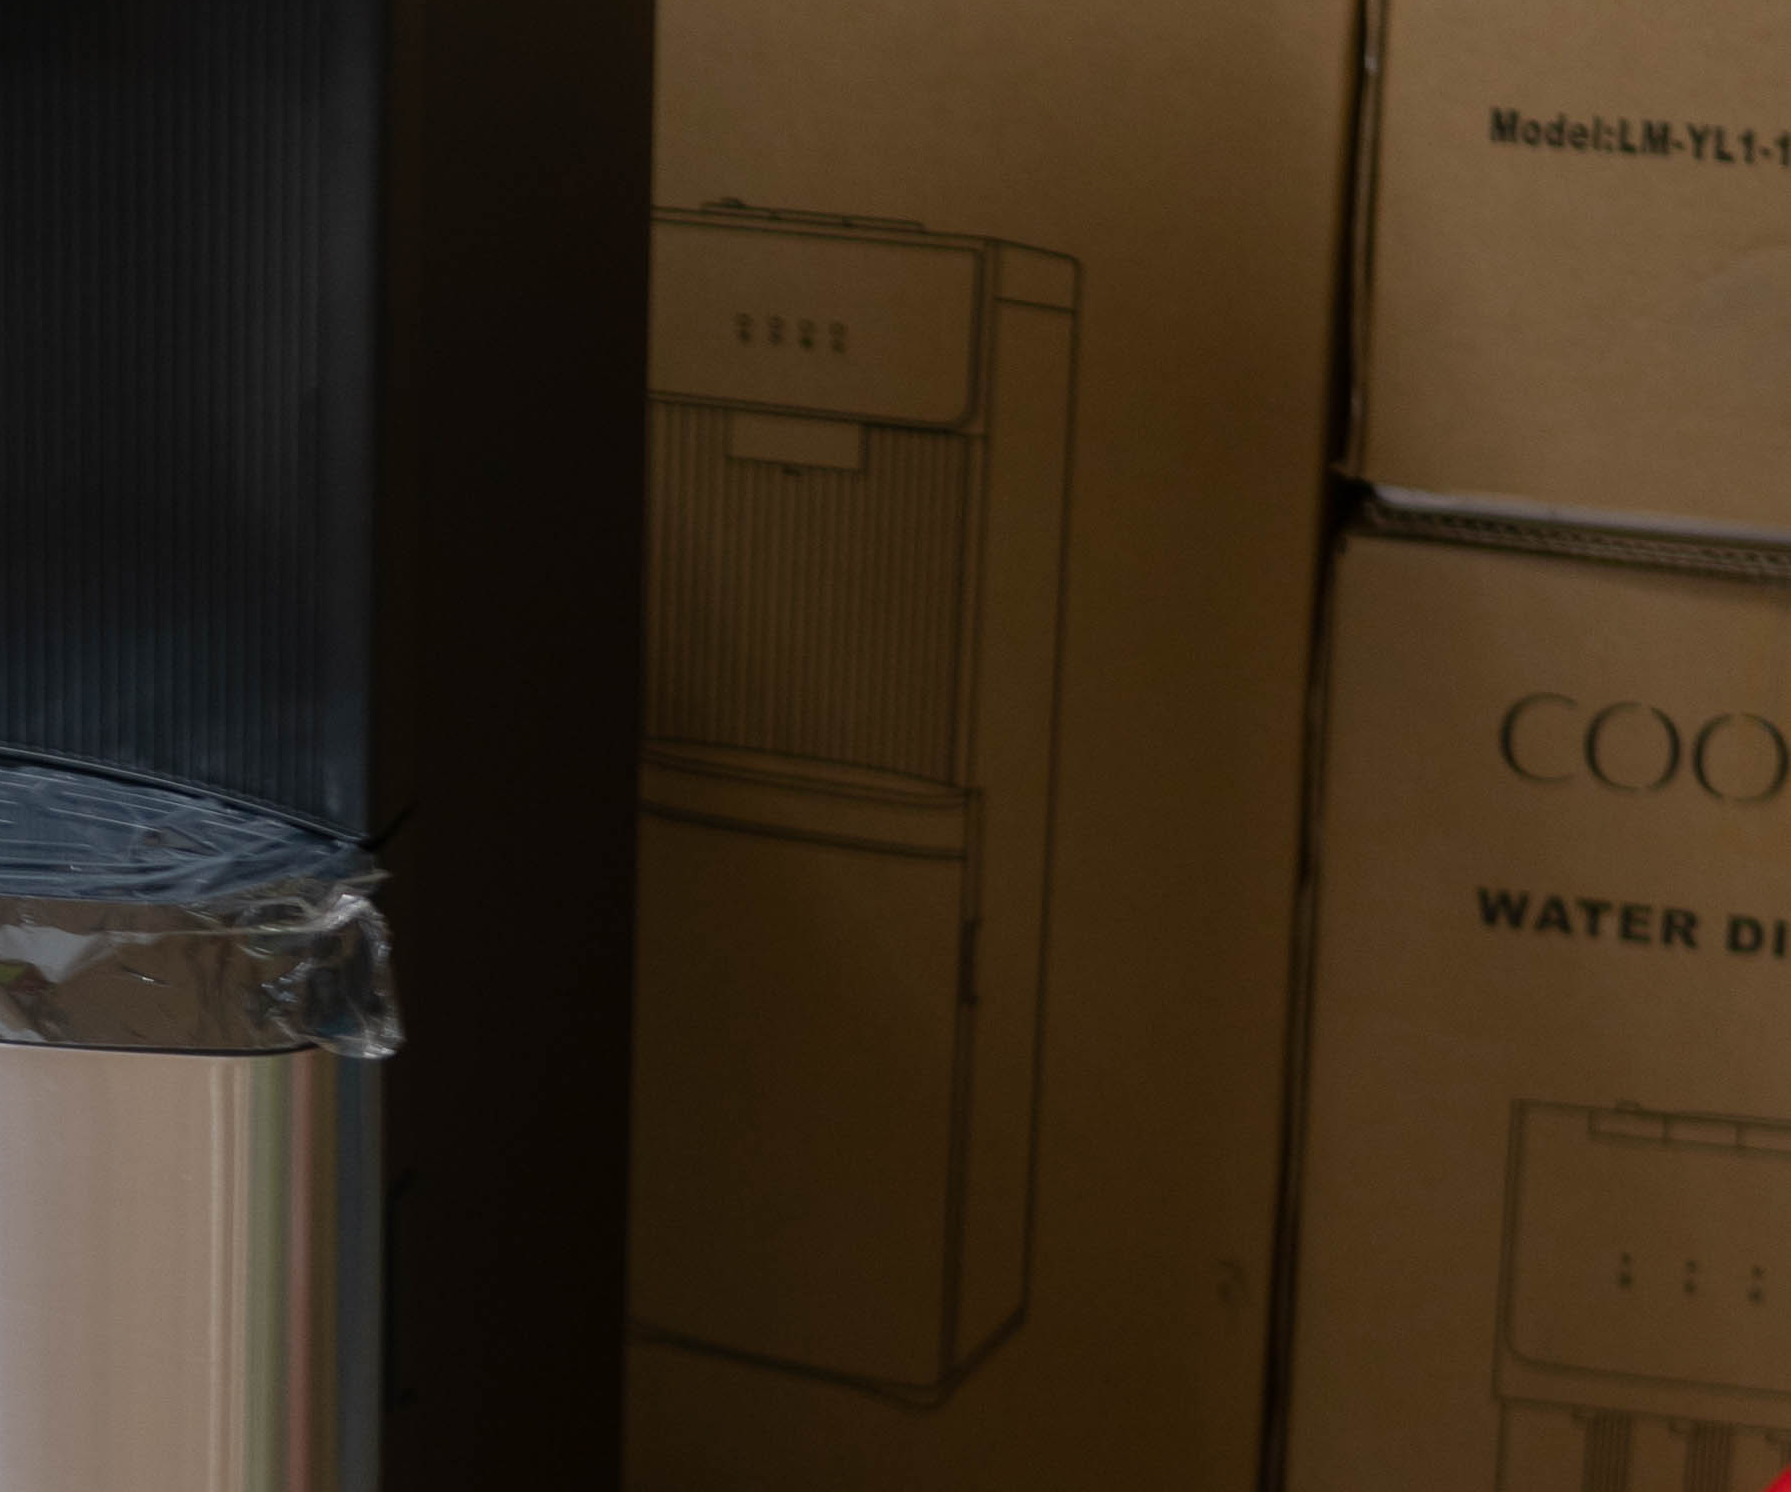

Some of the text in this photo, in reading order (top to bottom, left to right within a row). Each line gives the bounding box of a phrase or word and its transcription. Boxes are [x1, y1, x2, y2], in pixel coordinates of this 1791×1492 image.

[1499, 691, 1791, 804] COO
[1477, 886, 1788, 960] WATER DI
